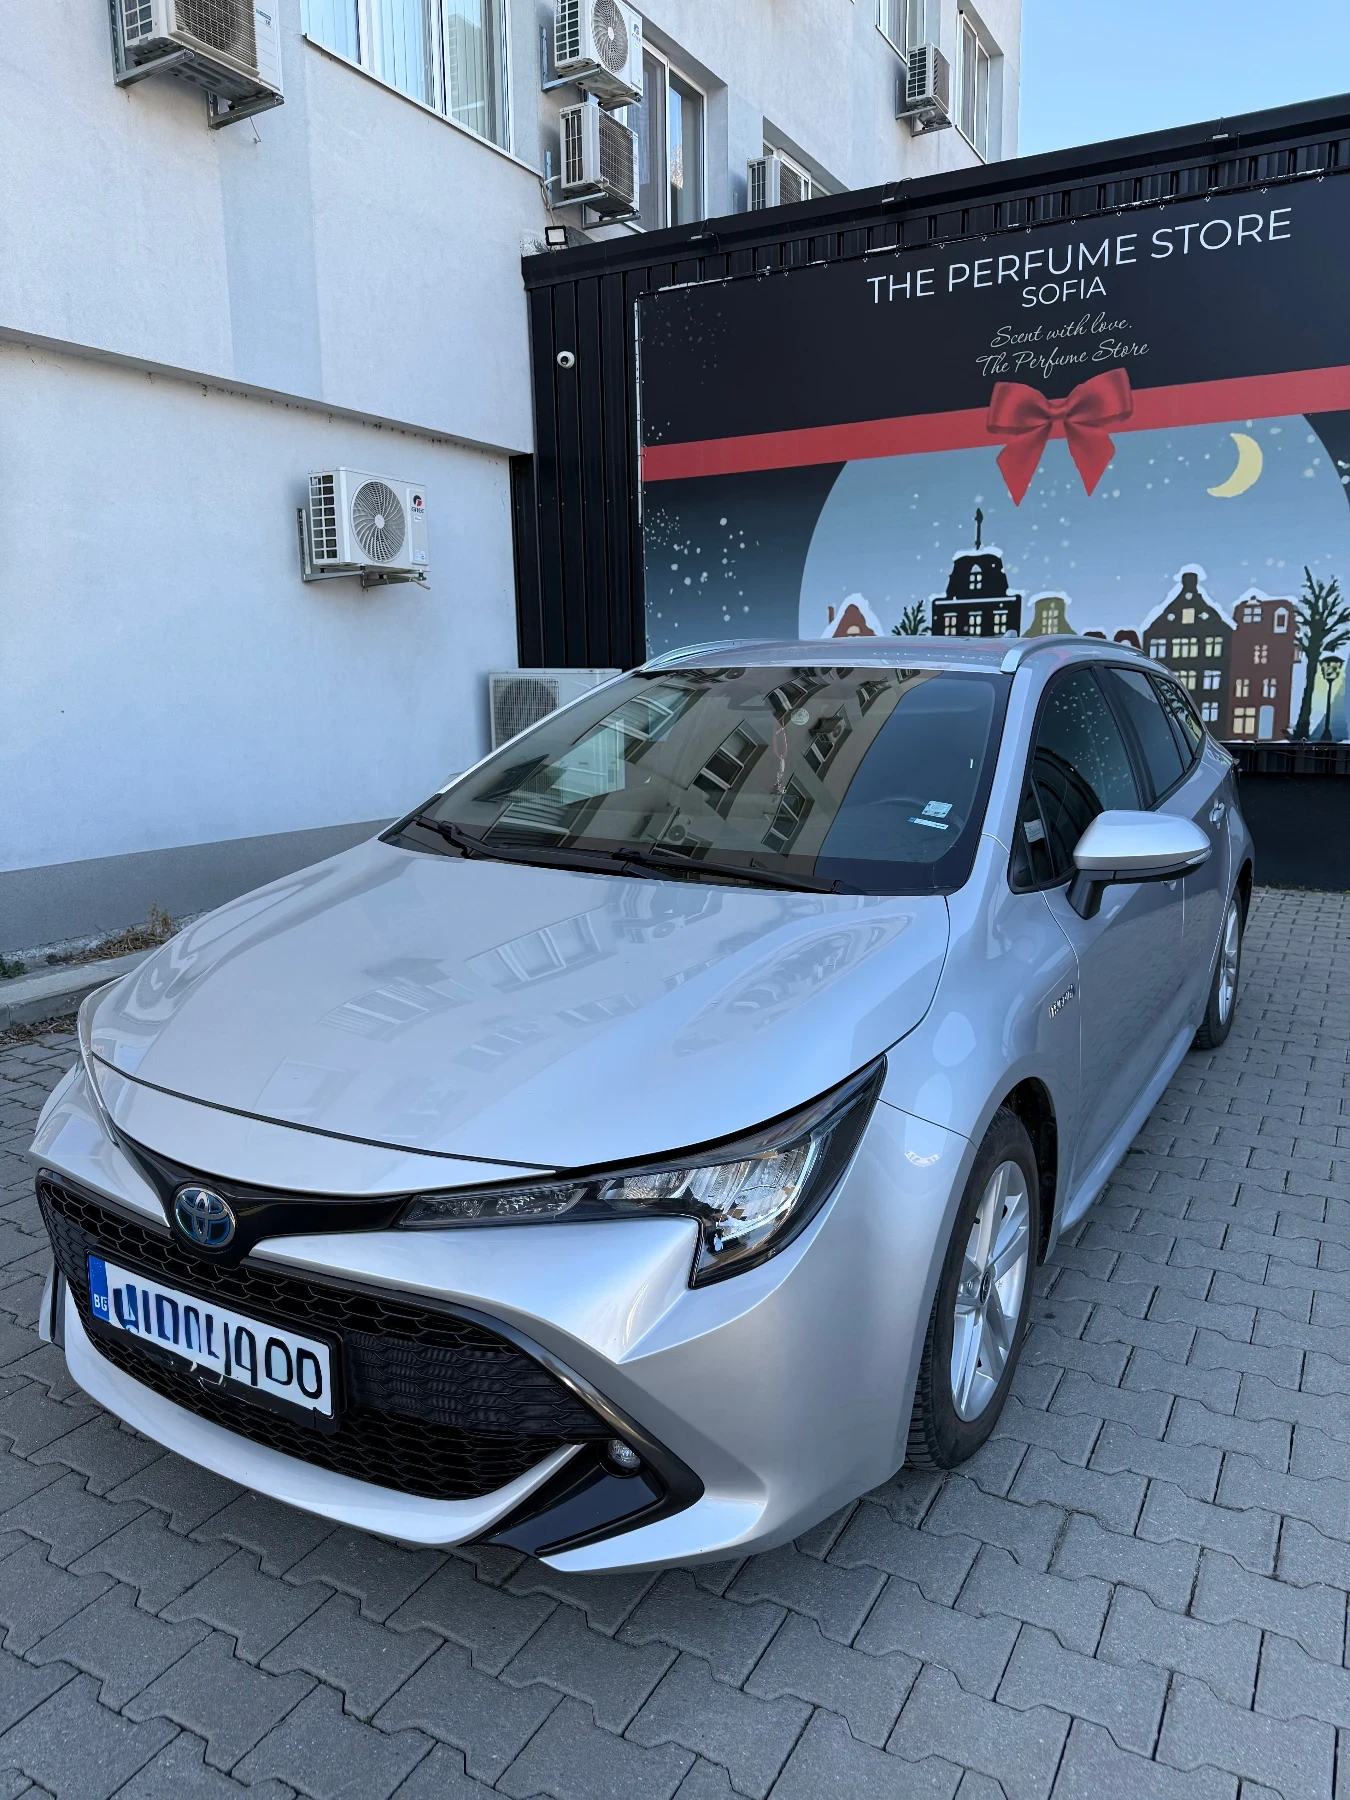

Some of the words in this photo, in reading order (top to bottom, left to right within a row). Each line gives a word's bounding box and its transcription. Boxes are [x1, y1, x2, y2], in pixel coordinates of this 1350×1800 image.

[867, 268, 935, 304] THE
[949, 233, 1138, 292] PERFUME
[1151, 207, 1292, 259] STORE
[1022, 277, 1107, 308] SOFIA
[990, 325, 1044, 348] Scent
[1046, 313, 1088, 341] with
[1090, 311, 1133, 334] love.
[975, 351, 1011, 376] The
[1012, 346, 1089, 379] Perfume
[1092, 338, 1150, 362] Store
[93, 1293, 108, 1312] BG
